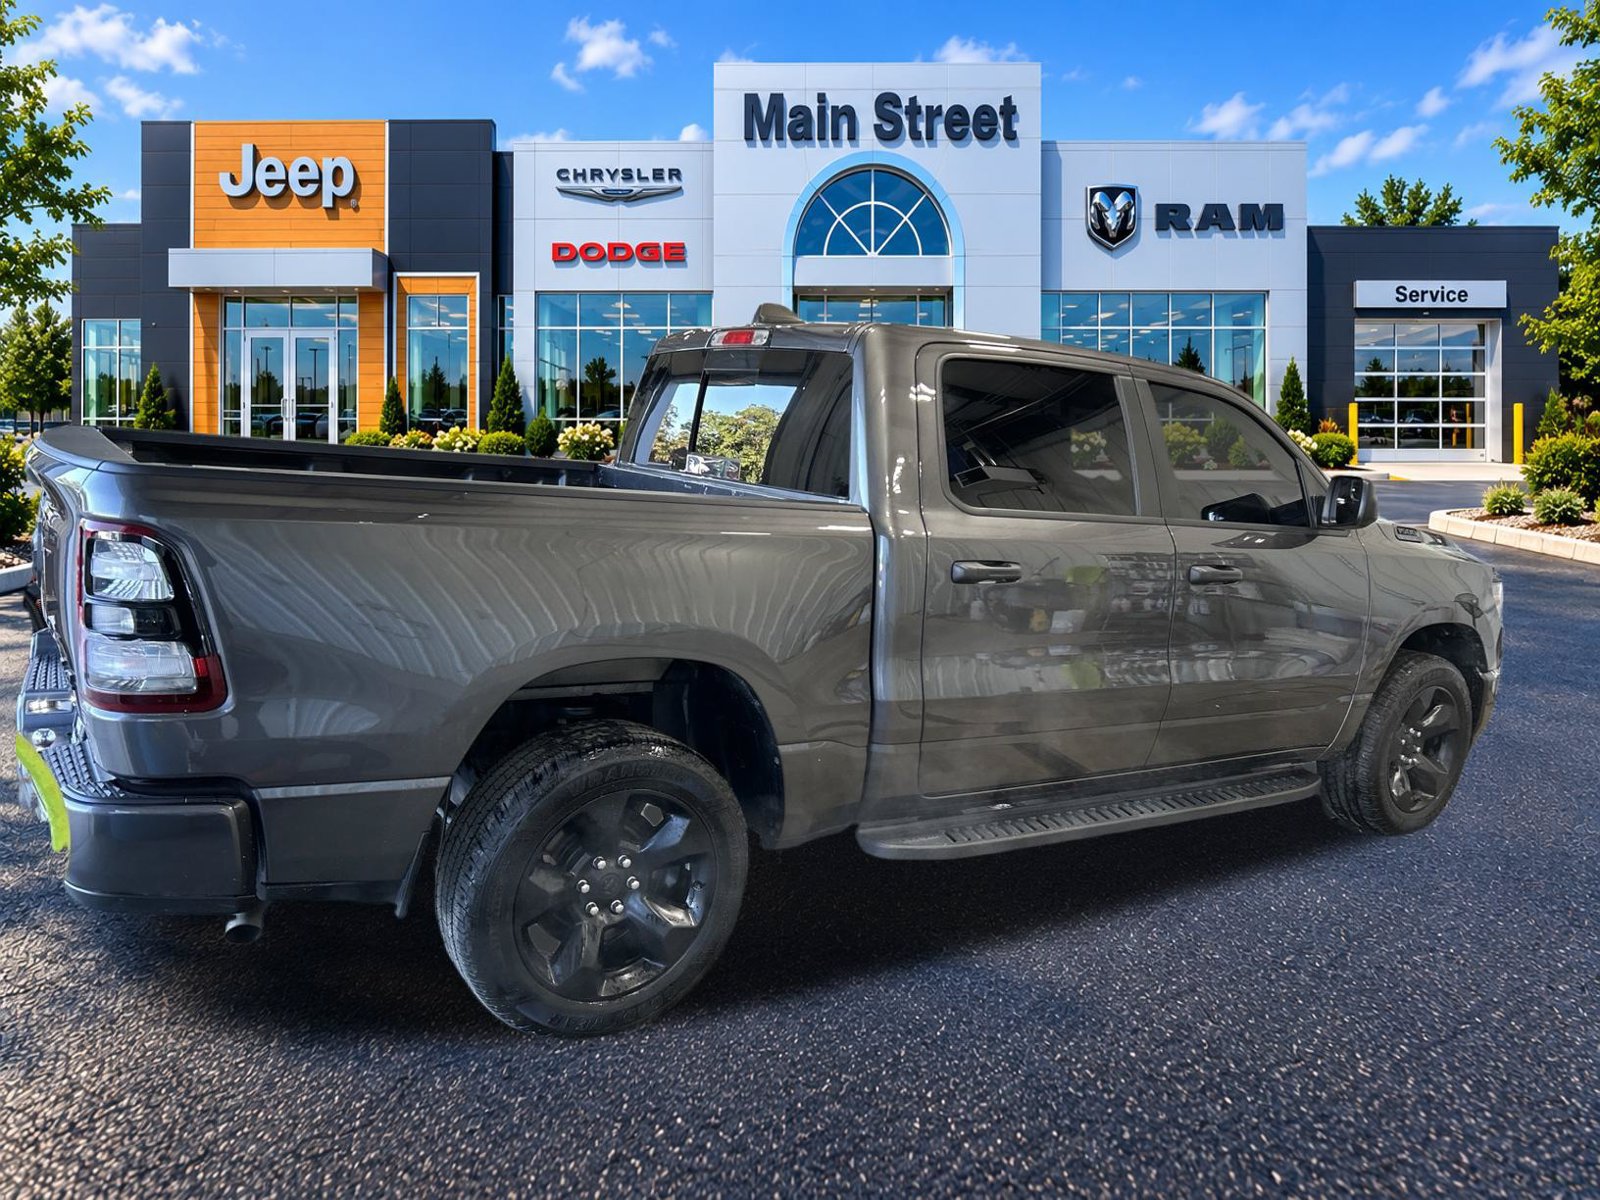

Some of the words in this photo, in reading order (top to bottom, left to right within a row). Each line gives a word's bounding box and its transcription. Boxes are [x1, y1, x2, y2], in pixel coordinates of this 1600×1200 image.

[744, 93, 857, 141] Main
[873, 91, 1018, 142] Street
[218, 143, 355, 209] Jeep
[556, 168, 683, 182] CHRYSLER
[1155, 203, 1284, 231] RAM
[551, 242, 687, 262] DODGE
[1395, 285, 1469, 303] Service
